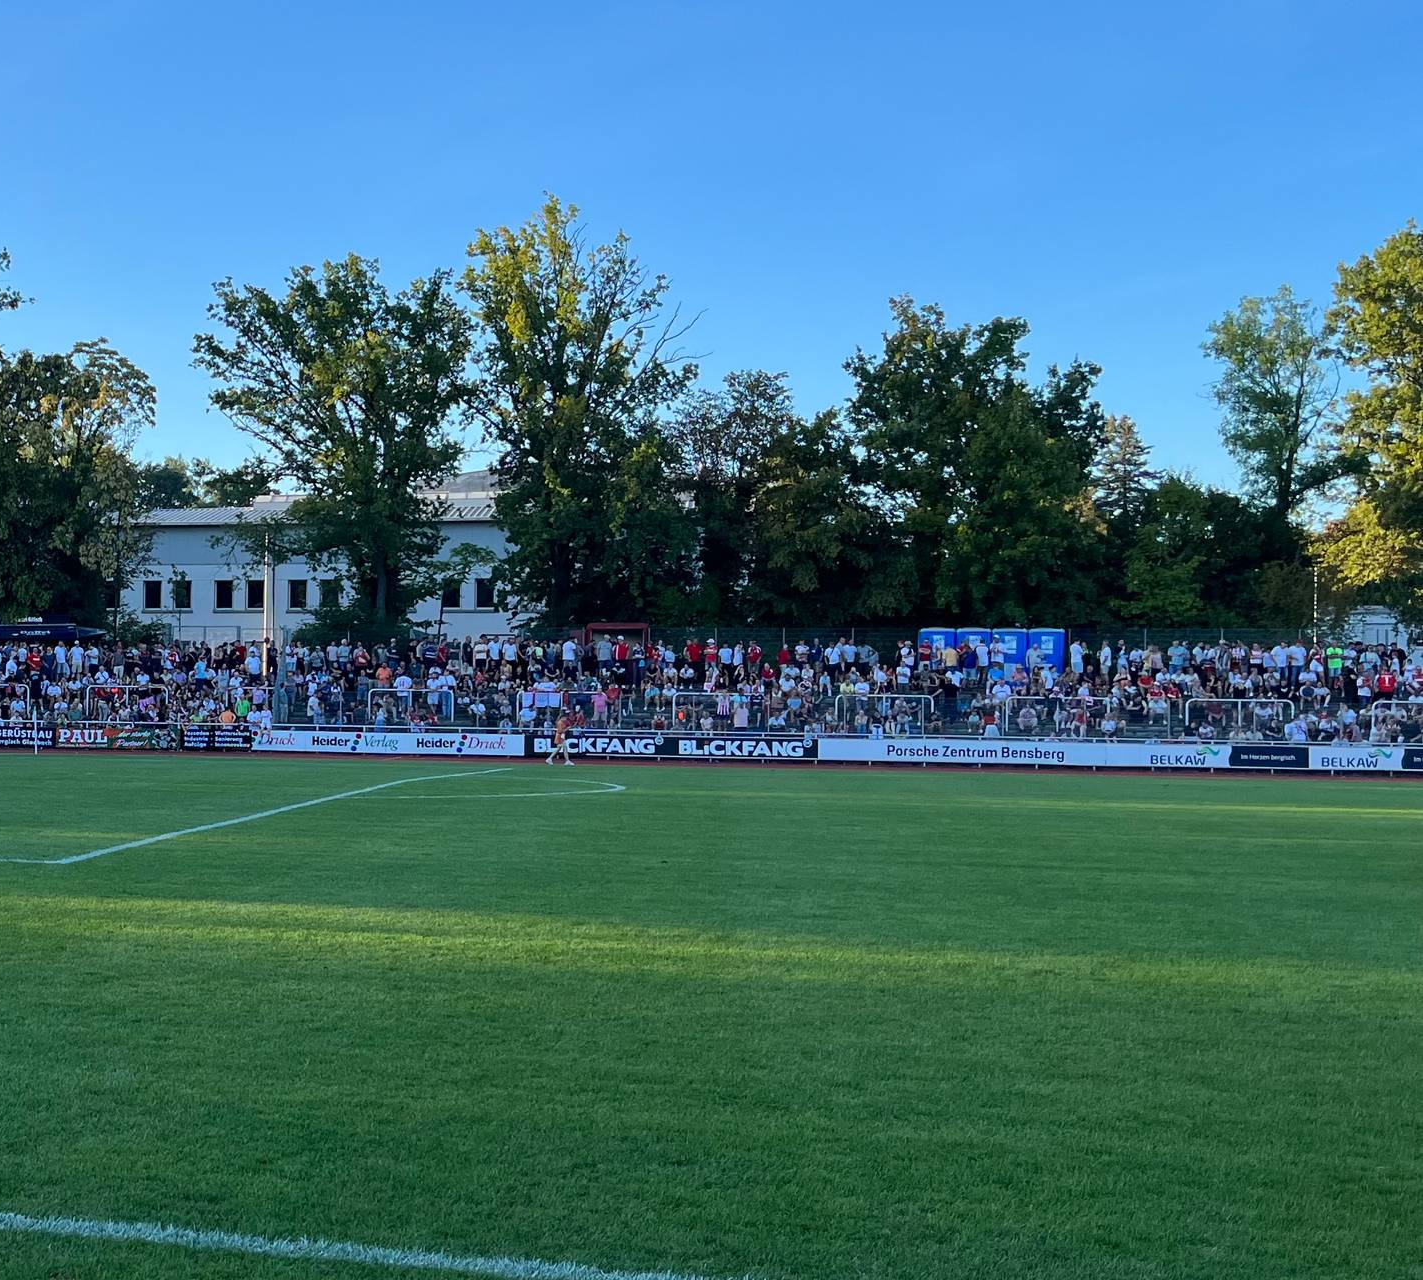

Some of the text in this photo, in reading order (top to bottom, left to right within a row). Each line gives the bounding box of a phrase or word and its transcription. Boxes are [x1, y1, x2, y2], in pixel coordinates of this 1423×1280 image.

[58, 729, 108, 743] PAUL
[258, 733, 295, 746] Druck
[416, 736, 506, 749] Heider Druck
[312, 735, 399, 751] Heider Verlag
[886, 744, 1065, 763] Porsche Zentrum Bensberg
[1150, 754, 1207, 766] BELKAW
[1321, 756, 1378, 768] BELKAW
